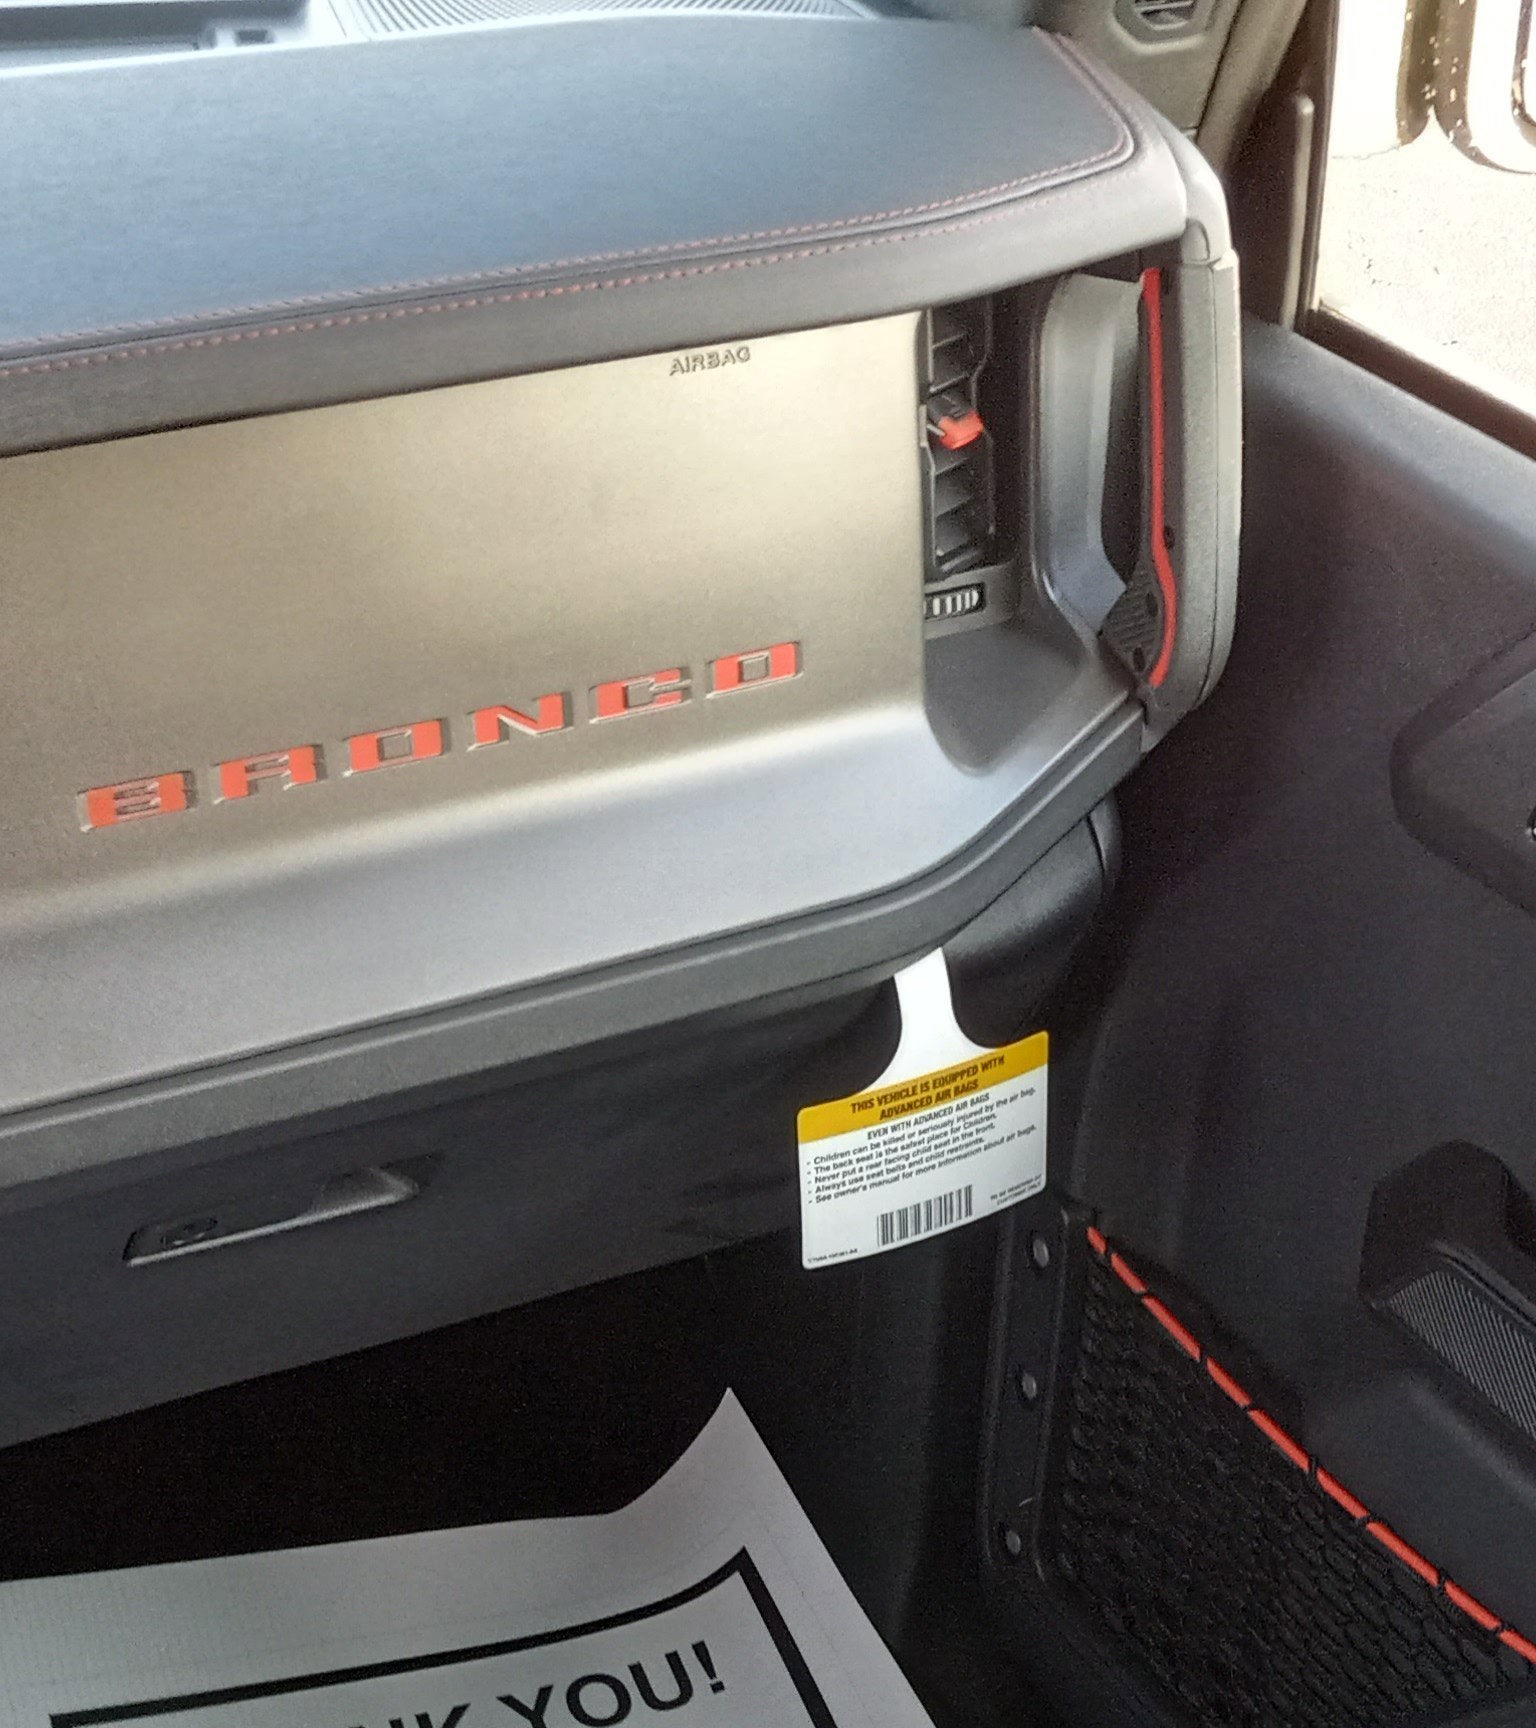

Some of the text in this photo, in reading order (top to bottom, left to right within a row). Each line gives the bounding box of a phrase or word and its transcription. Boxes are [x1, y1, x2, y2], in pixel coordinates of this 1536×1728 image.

[669, 346, 751, 376] AIRBAG
[76, 640, 802, 832] BRONCO
[850, 1055, 1005, 1114] THIS VEHICLE IS EQUIPPED WITH
[880, 1079, 979, 1120] ADVANCED AIR BAGS
[867, 1093, 990, 1140] EVEN WITH ADVANCED AIR BAGS
